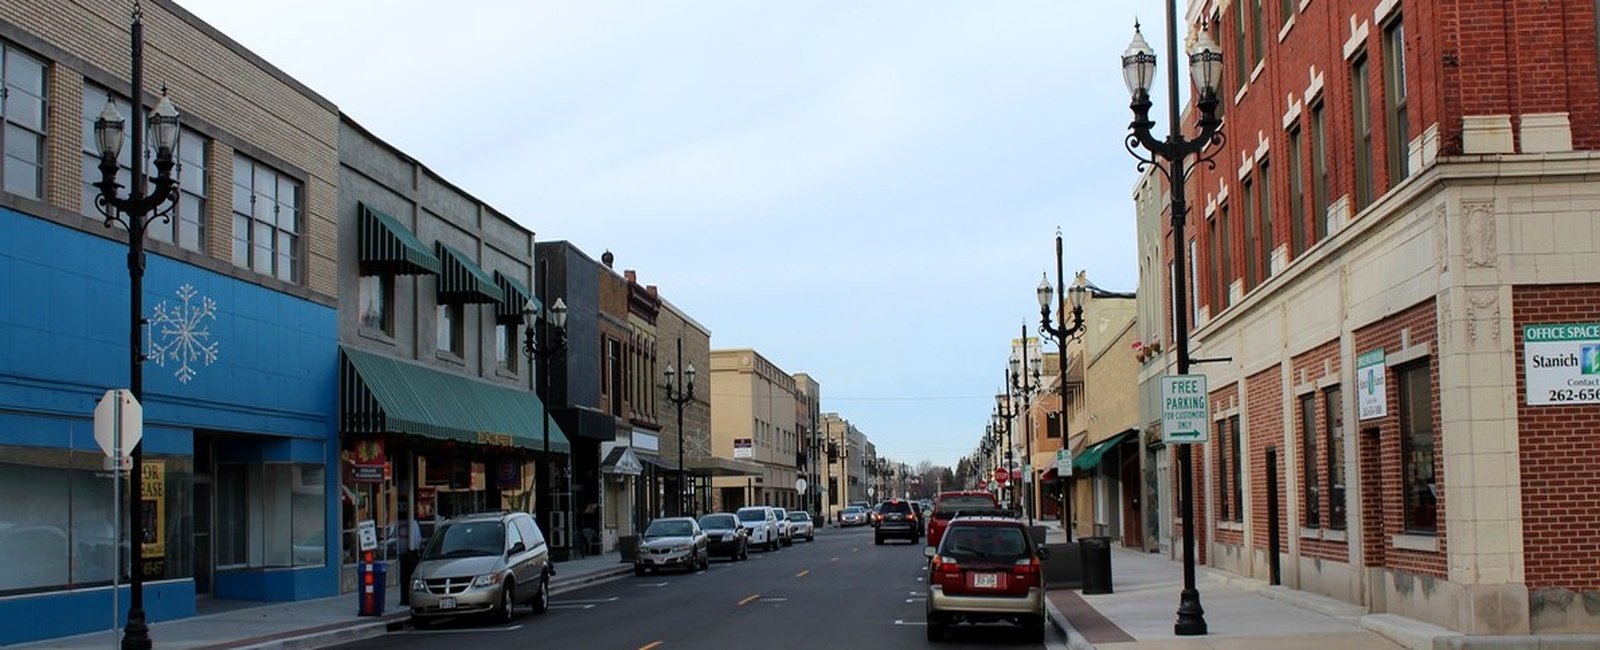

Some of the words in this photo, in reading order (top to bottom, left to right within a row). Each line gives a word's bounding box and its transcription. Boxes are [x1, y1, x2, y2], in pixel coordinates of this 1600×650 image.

[1526, 327, 1564, 340] OFFICE
[1567, 325, 1600, 338] SPACE
[1533, 353, 1578, 369] Stanich
[1172, 380, 1198, 394] FREE
[1567, 378, 1600, 386] Contact
[1166, 396, 1205, 410] PARKING
[143, 464, 159, 480] OR
